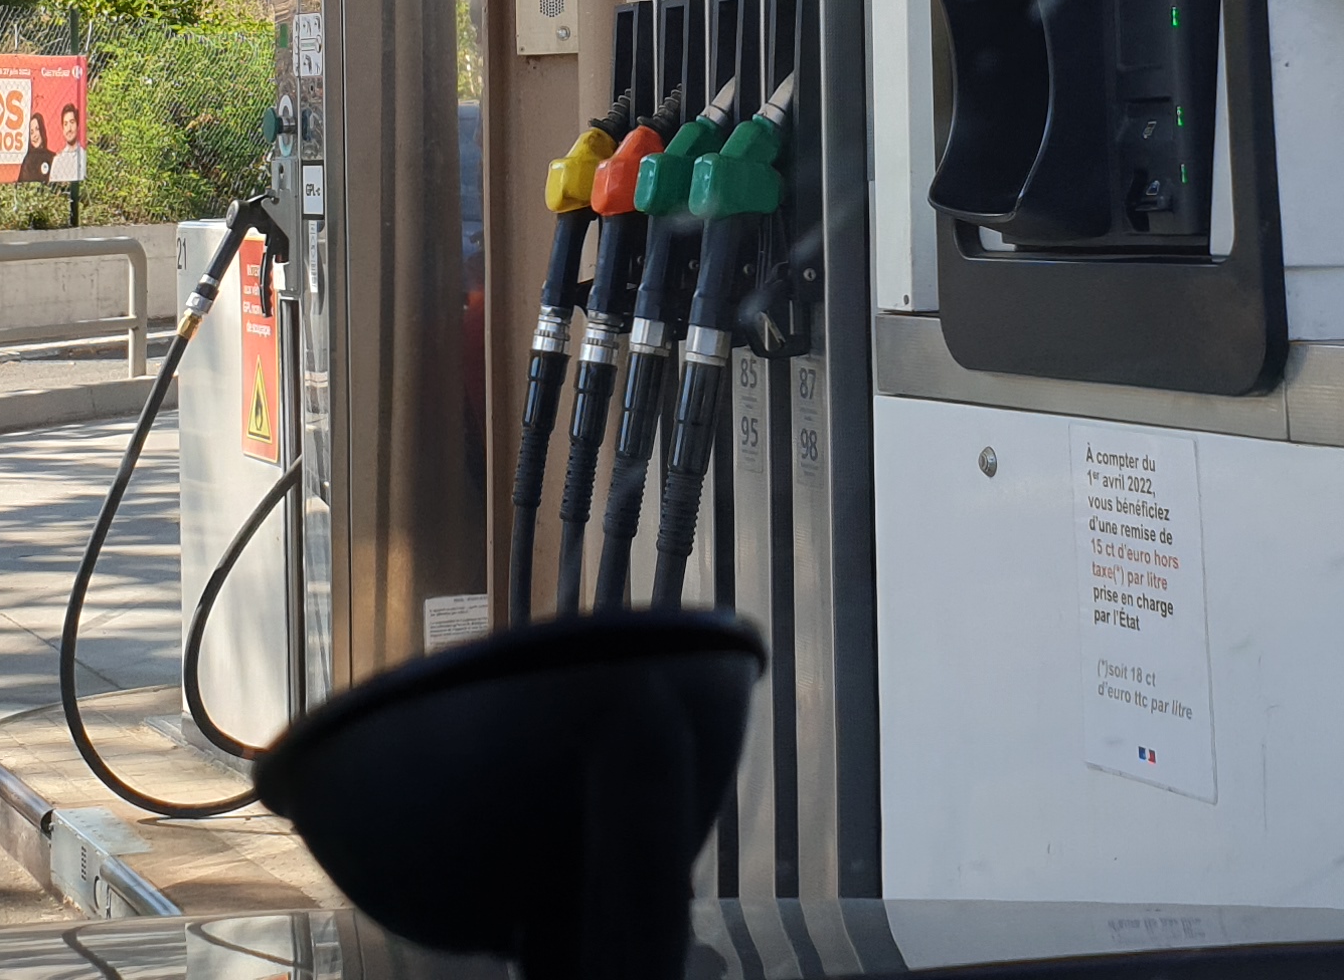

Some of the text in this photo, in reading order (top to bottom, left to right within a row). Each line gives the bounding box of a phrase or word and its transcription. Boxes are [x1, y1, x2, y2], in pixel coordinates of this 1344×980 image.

[176, 236, 187, 271] 21
[740, 357, 758, 389] 85
[798, 367, 817, 400] 87
[740, 415, 759, 448] 95
[799, 428, 819, 462] 98
[1085, 442, 1156, 473] À compter du
[1102, 473, 1125, 491] avril
[1126, 475, 1156, 498] 2022,
[1087, 495, 1170, 522] vous bénéficiez
[1120, 522, 1157, 543] remise
[1159, 526, 1173, 546] de
[1090, 537, 1103, 555] 15
[1105, 541, 1116, 558] ct
[1153, 548, 1180, 570] hors
[1127, 570, 1144, 588] par
[1146, 570, 1168, 592] litre
[1093, 584, 1174, 619] prise en charge
[1094, 608, 1111, 626] par
[1130, 665, 1143, 684] 18
[1145, 671, 1156, 688] ct
[1134, 689, 1149, 709] ttc
[1150, 696, 1170, 715] par
[1171, 699, 1193, 721] litre
